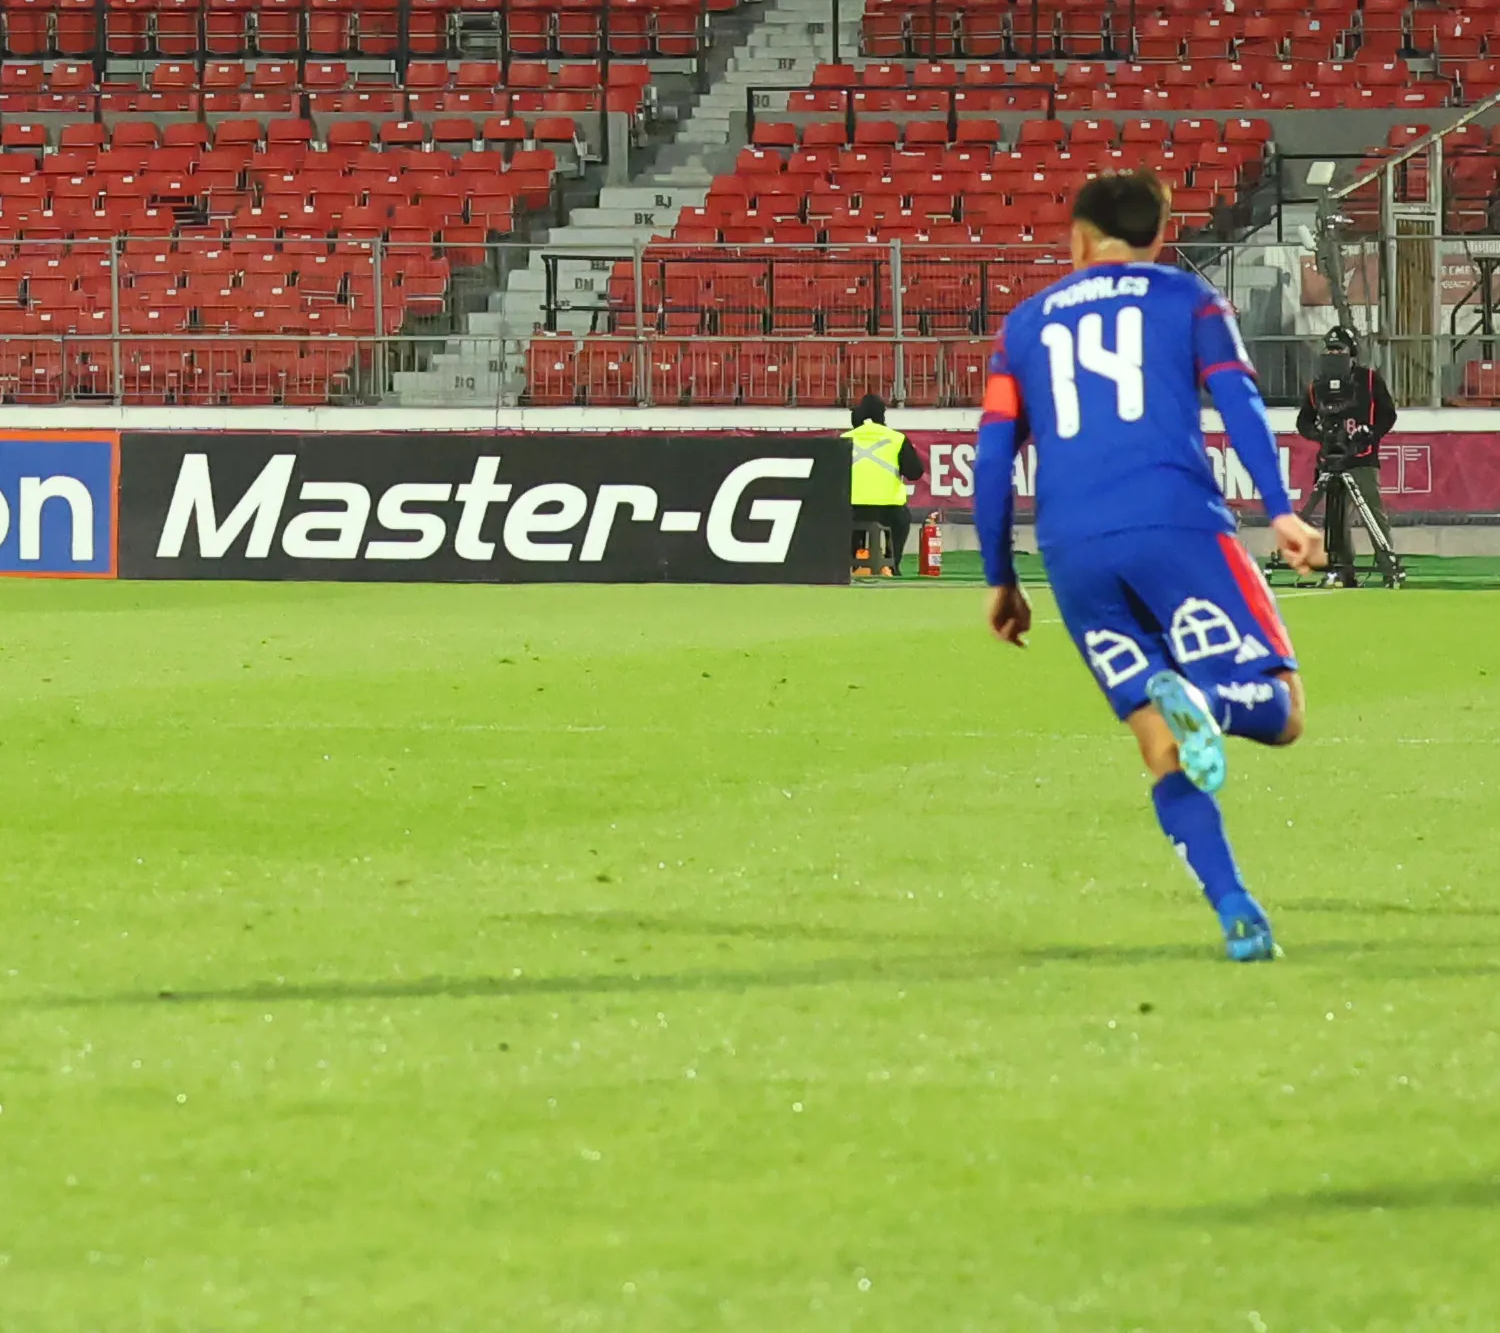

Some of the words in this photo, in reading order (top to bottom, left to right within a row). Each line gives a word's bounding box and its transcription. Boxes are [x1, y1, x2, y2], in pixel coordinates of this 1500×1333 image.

[635, 213, 654, 227] BK
[1041, 306, 1144, 439] 14
[156, 453, 814, 564] Master-G
